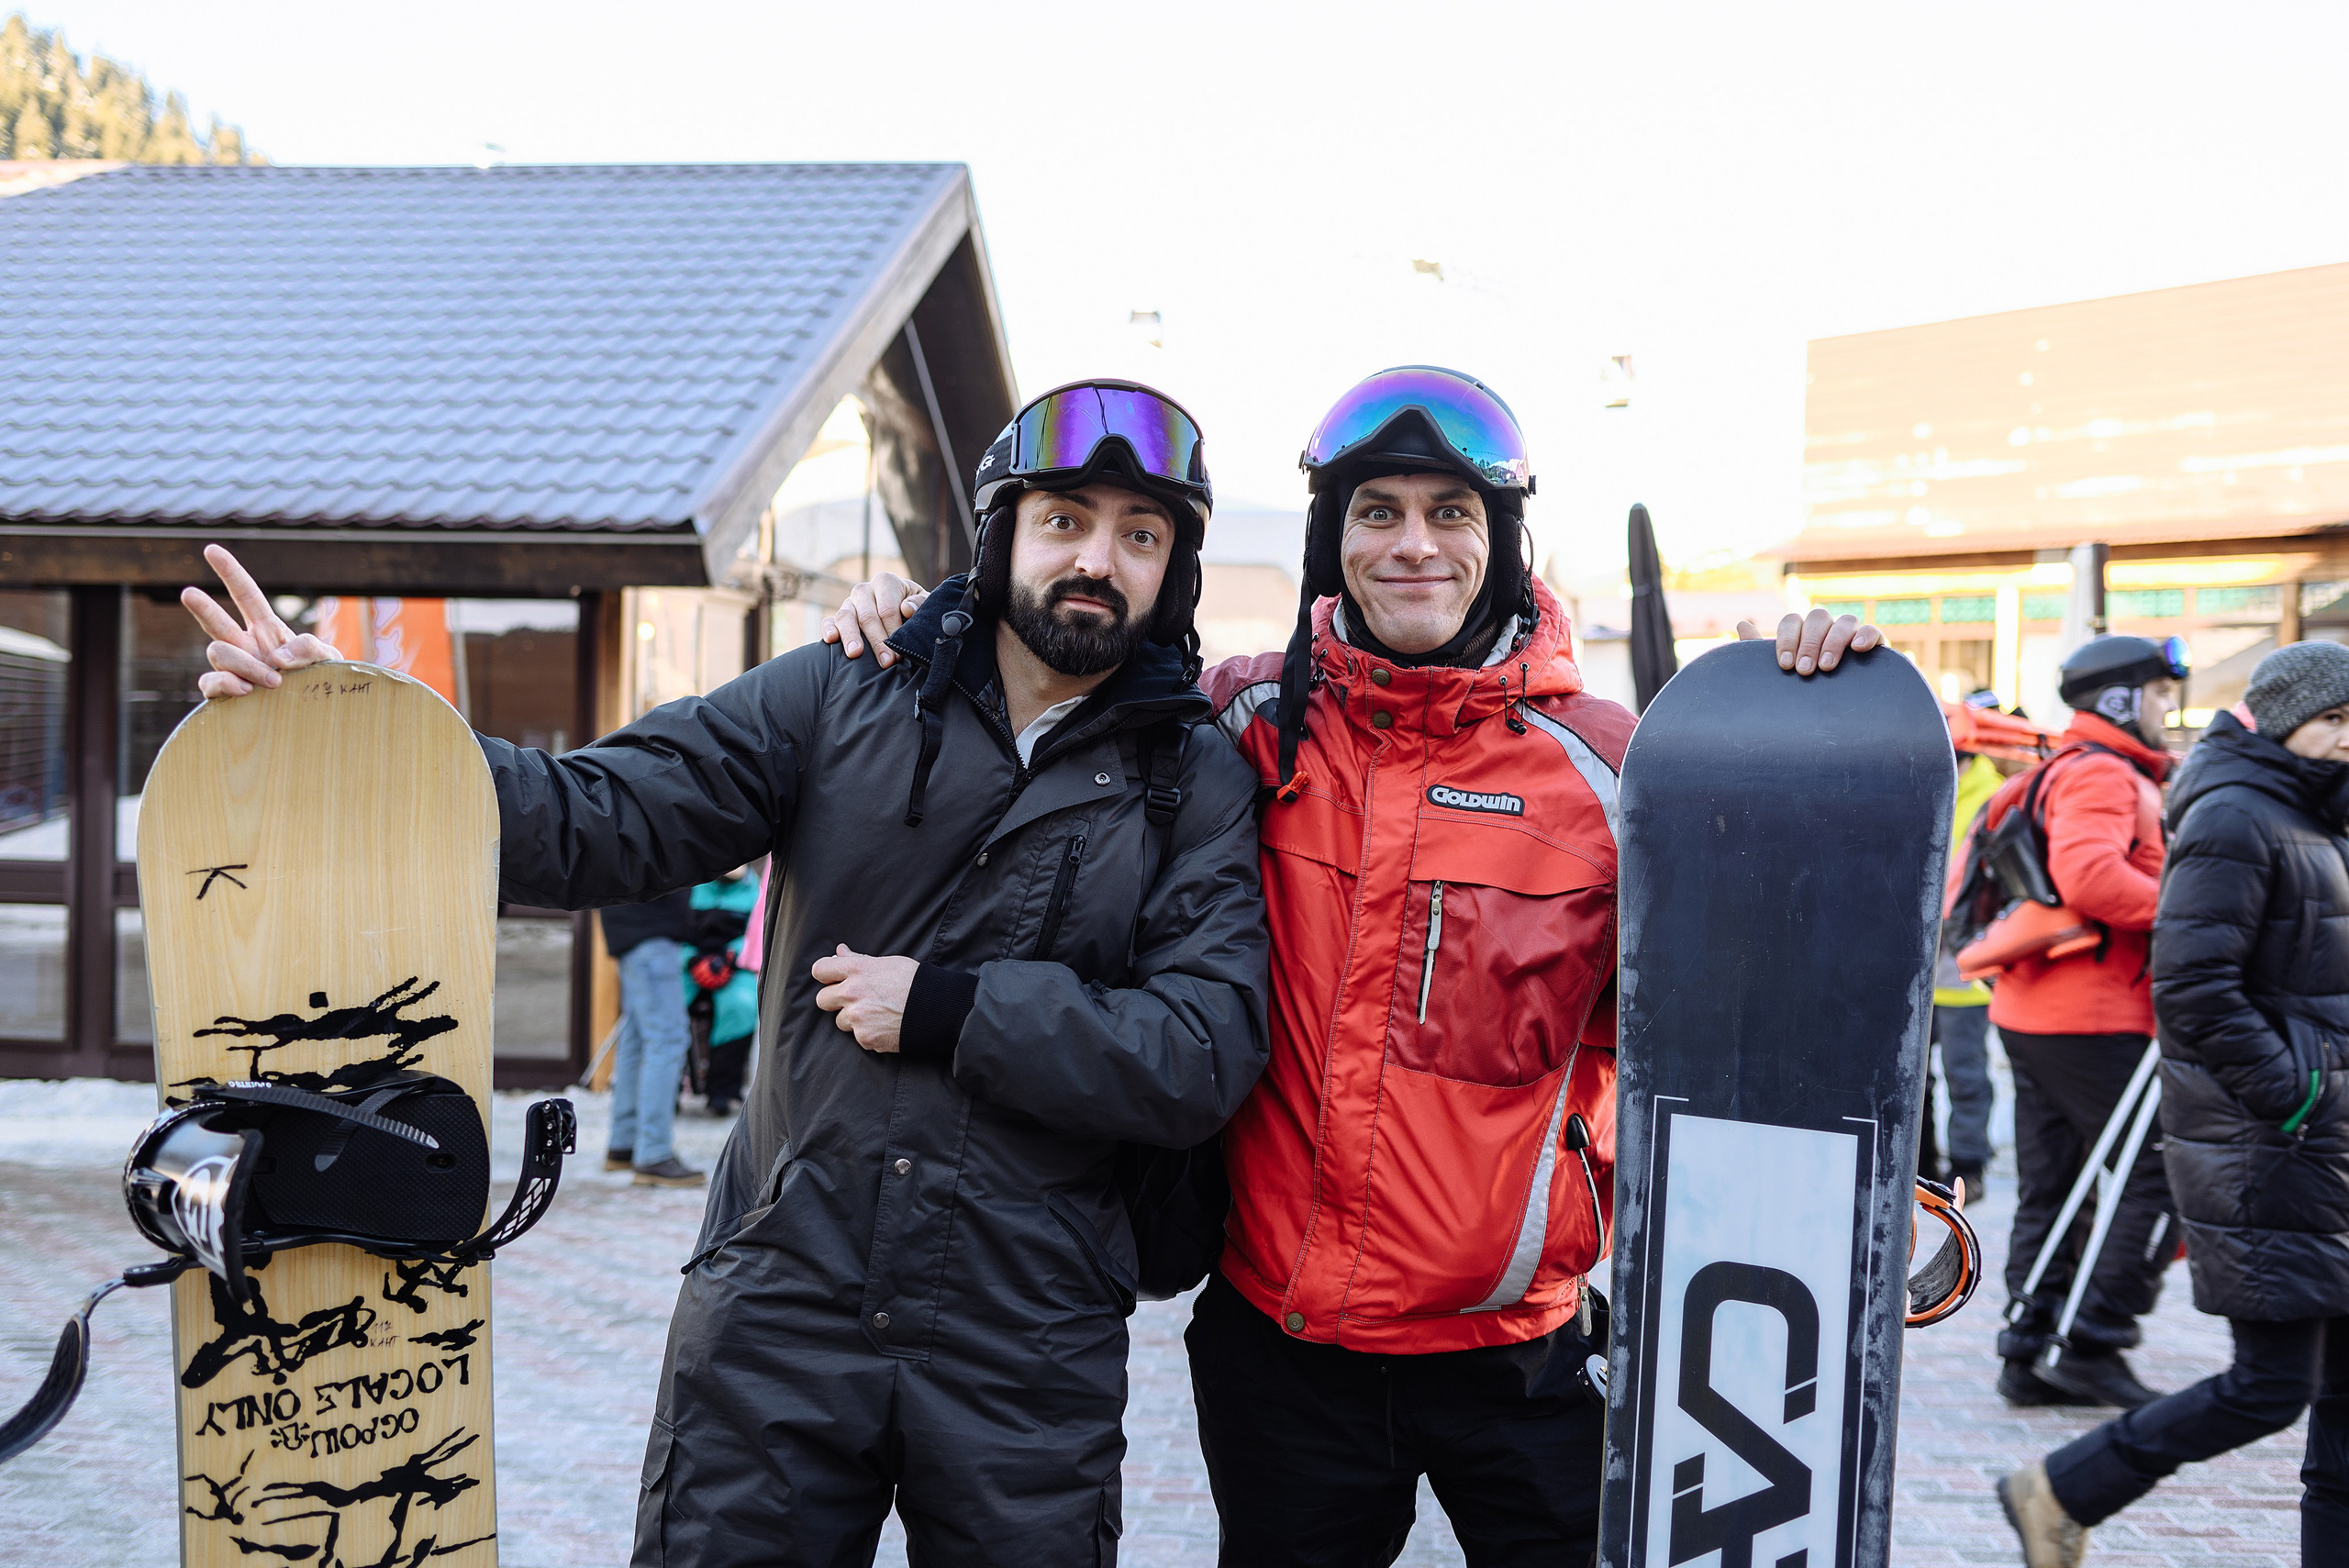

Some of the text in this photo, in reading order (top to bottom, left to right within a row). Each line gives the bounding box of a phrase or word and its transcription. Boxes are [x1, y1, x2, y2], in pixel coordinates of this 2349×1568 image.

[195, 1353, 471, 1437] LOCALS ONLY
[1668, 1260, 1820, 1568] CA
